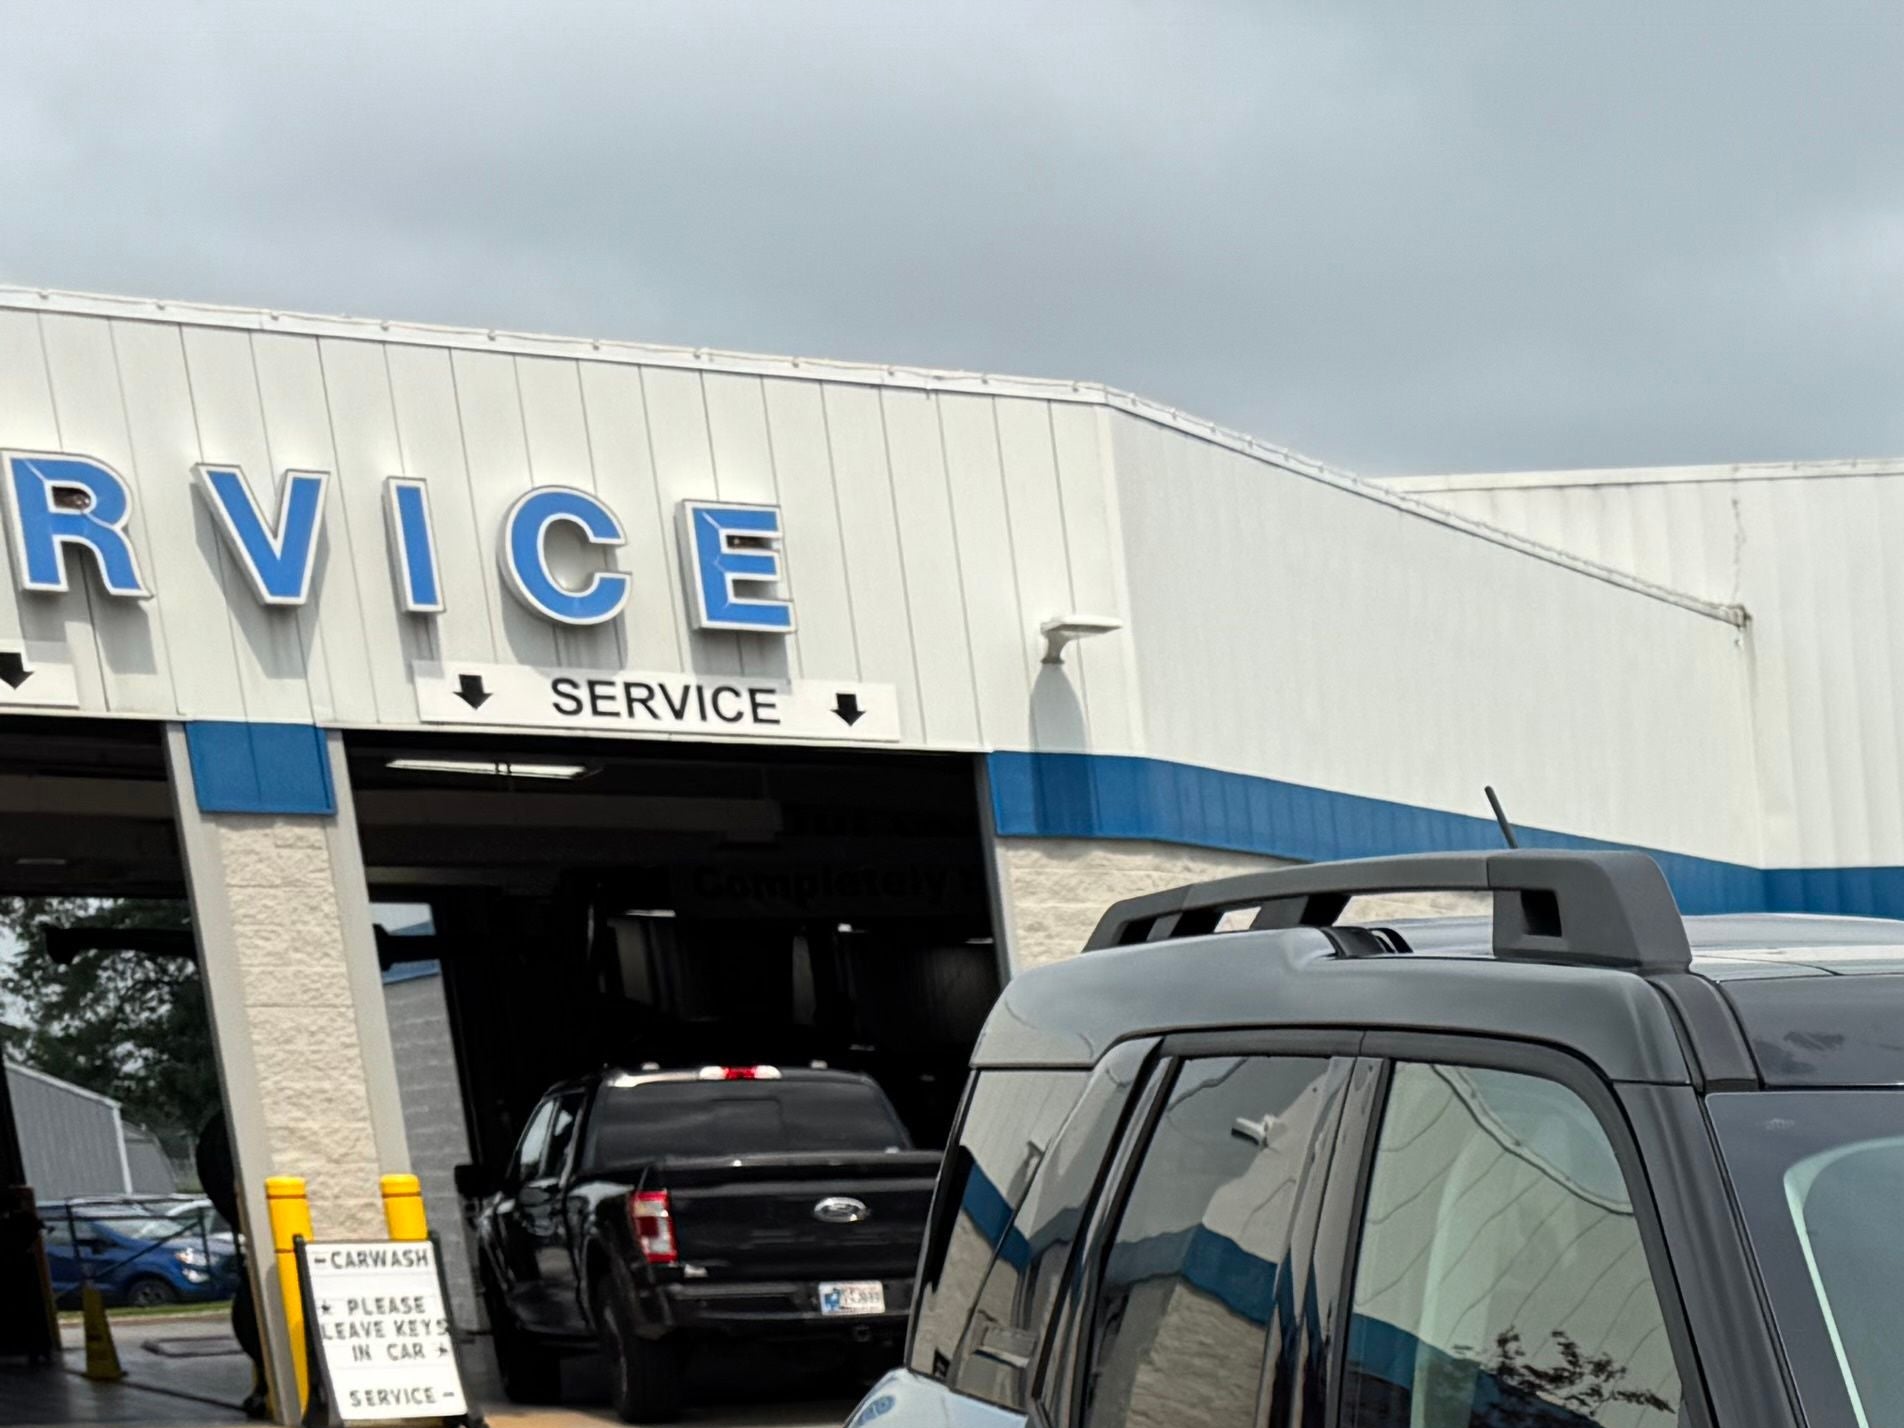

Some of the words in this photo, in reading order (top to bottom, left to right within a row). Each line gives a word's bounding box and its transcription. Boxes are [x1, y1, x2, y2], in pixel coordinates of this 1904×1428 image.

[1, 447, 797, 635] RVICE
[551, 677, 781, 725] SERVICE
[330, 1249, 429, 1269] CARWASH
[346, 1296, 426, 1315] PLEASE
[321, 1320, 387, 1340] LEAVE
[393, 1318, 450, 1338] KEYS
[352, 1344, 372, 1362] IN
[386, 1343, 426, 1361] CAR
[349, 1386, 437, 1407] SERVICE
